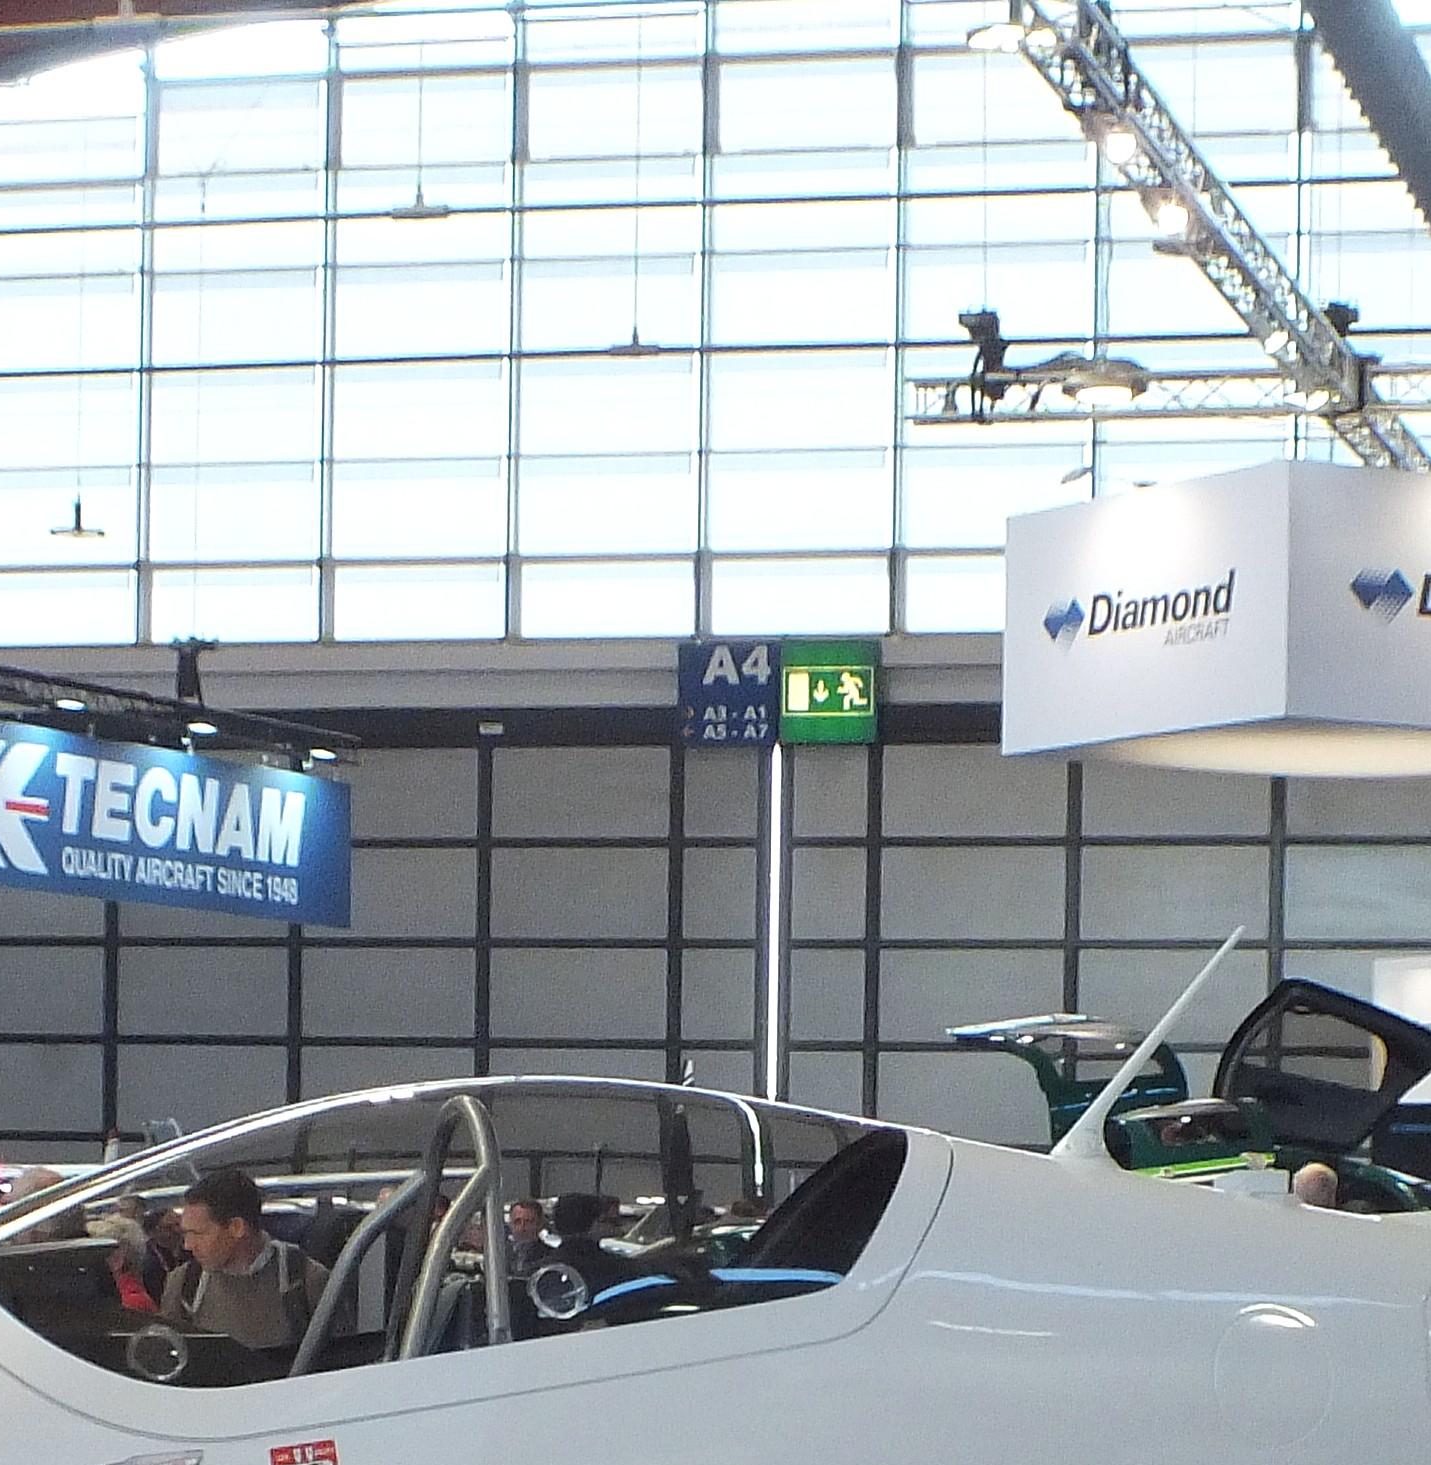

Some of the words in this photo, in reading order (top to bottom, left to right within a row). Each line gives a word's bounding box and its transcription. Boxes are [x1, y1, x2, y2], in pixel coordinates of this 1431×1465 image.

[1088, 567, 1236, 636] Diamond
[1164, 617, 1229, 646] AIRCRAFT
[702, 645, 770, 685] A4
[744, 723, 768, 738] A7
[56, 752, 306, 867] TECNAM
[62, 846, 133, 882] QUALITY
[135, 856, 214, 892] AIRCRAFT
[217, 866, 263, 901] SINCE
[266, 875, 299, 906] 1948
